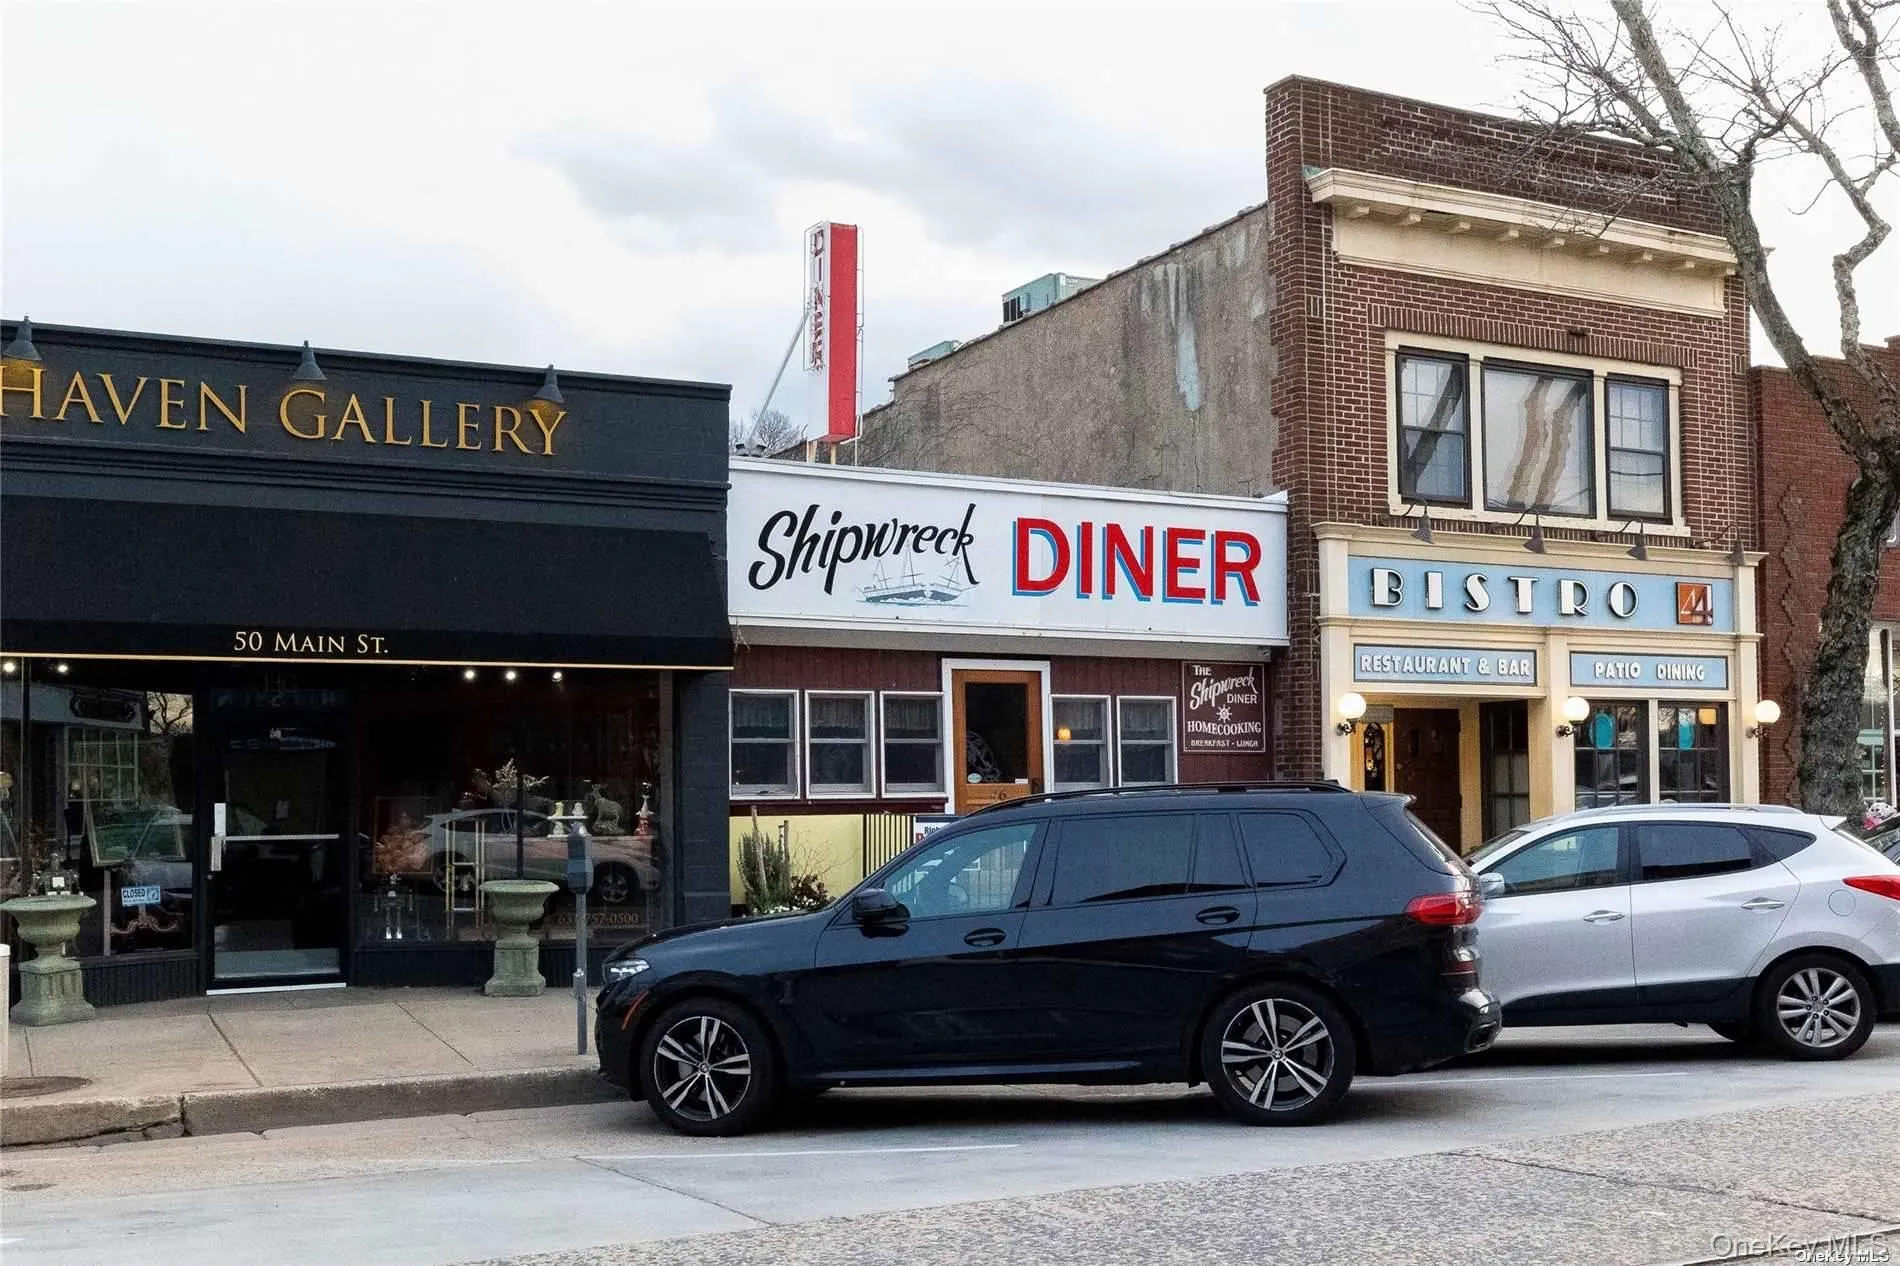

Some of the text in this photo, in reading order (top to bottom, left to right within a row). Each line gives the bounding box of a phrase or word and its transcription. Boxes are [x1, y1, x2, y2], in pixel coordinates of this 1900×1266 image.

[0, 365, 567, 456] HAVEN GALLERY
[748, 502, 1261, 606] Shipwreck DINER
[1370, 567, 1639, 619] BISTRO
[234, 631, 389, 654] 50 MAIN ST.
[1193, 665, 1211, 676] THE
[1361, 655, 1531, 677] RESTAURANT & BAR
[1594, 661, 1705, 681] PATIO DINING
[1190, 667, 1259, 710] Shipwreck
[1227, 693, 1257, 704] DINER
[1187, 720, 1262, 736] HOMECOOKING
[1236, 740, 1258, 748] LUNCH
[123, 888, 145, 898] CLOSED
